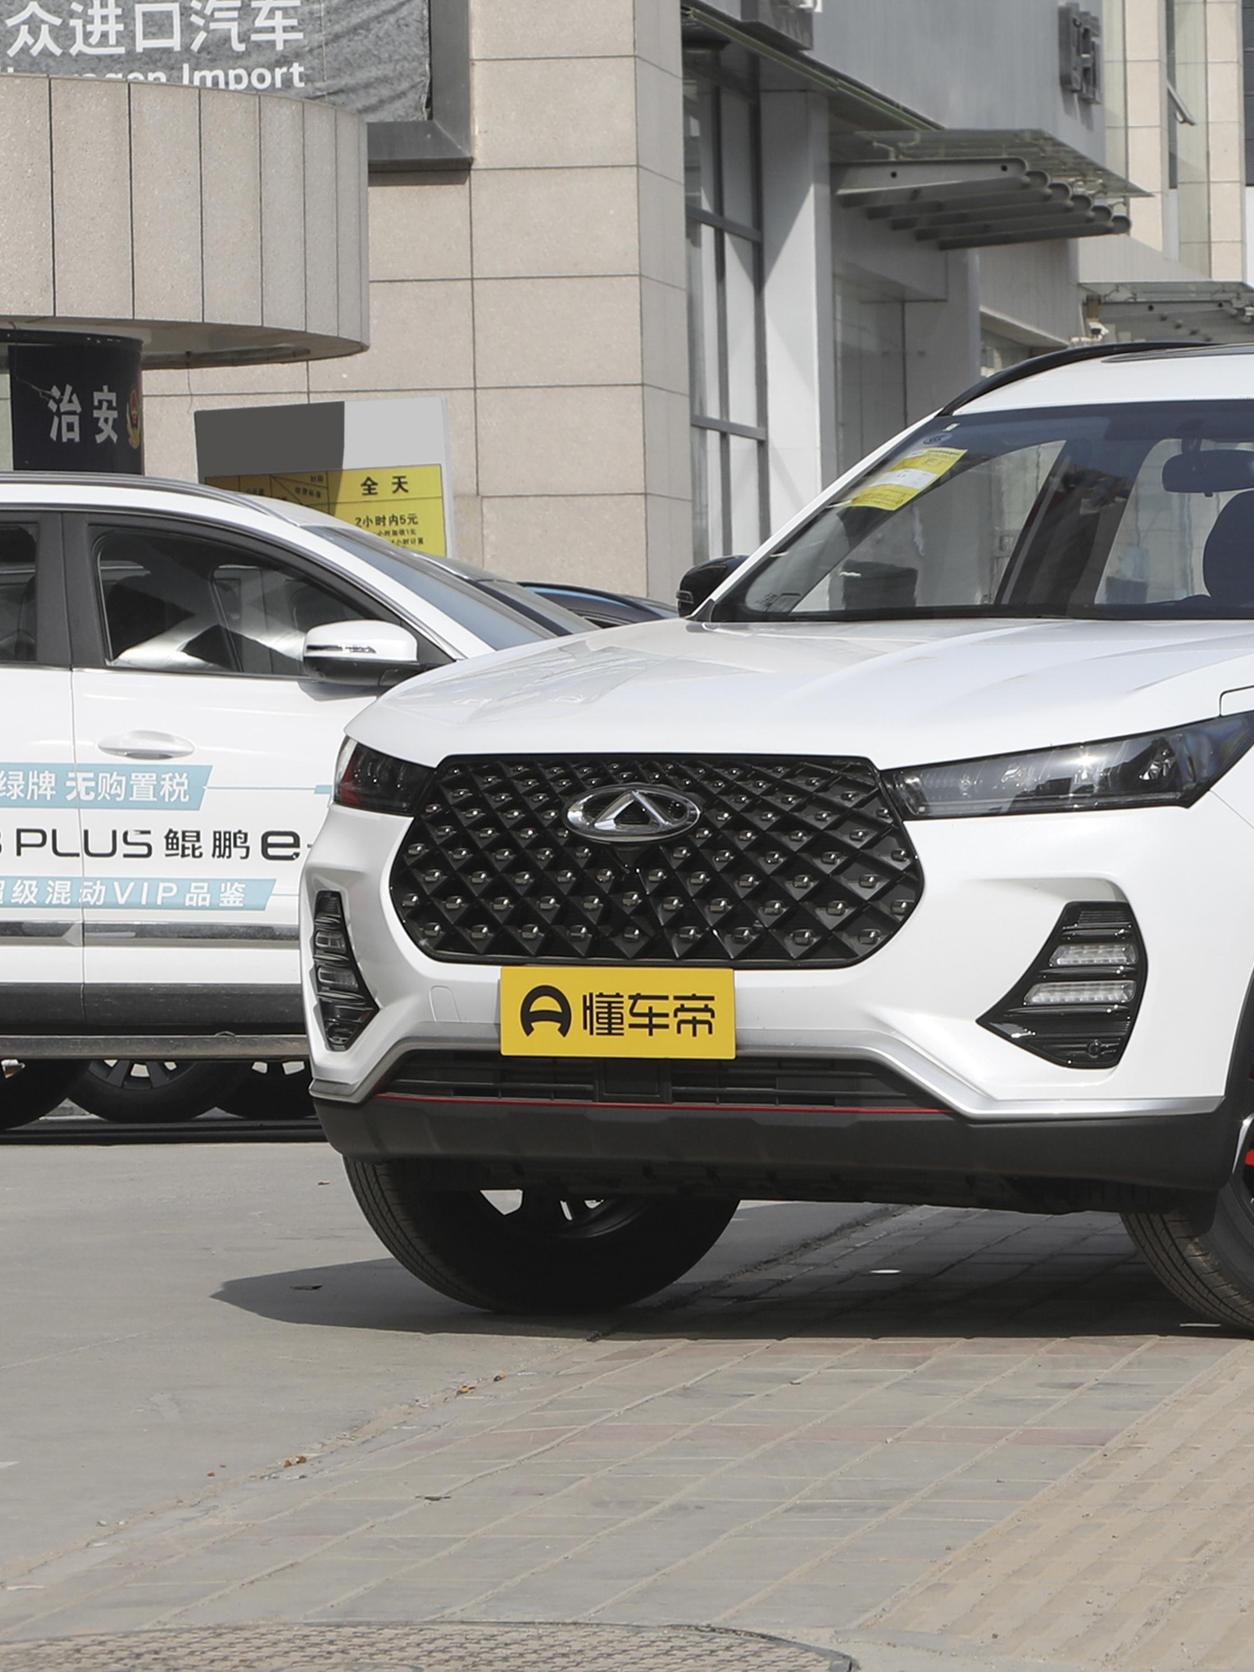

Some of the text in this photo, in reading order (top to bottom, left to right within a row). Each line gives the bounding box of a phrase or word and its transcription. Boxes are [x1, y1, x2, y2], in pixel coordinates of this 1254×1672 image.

[5, 0, 304, 57] 众进口汽车
[182, 62, 305, 90] Import
[48, 384, 118, 443] 治安
[361, 475, 409, 496] 全天
[64, 770, 190, 803] 无购置税
[16, 828, 153, 858] PLUS
[164, 828, 251, 860] 鲲鹏
[582, 992, 716, 1037] 懂车帝
